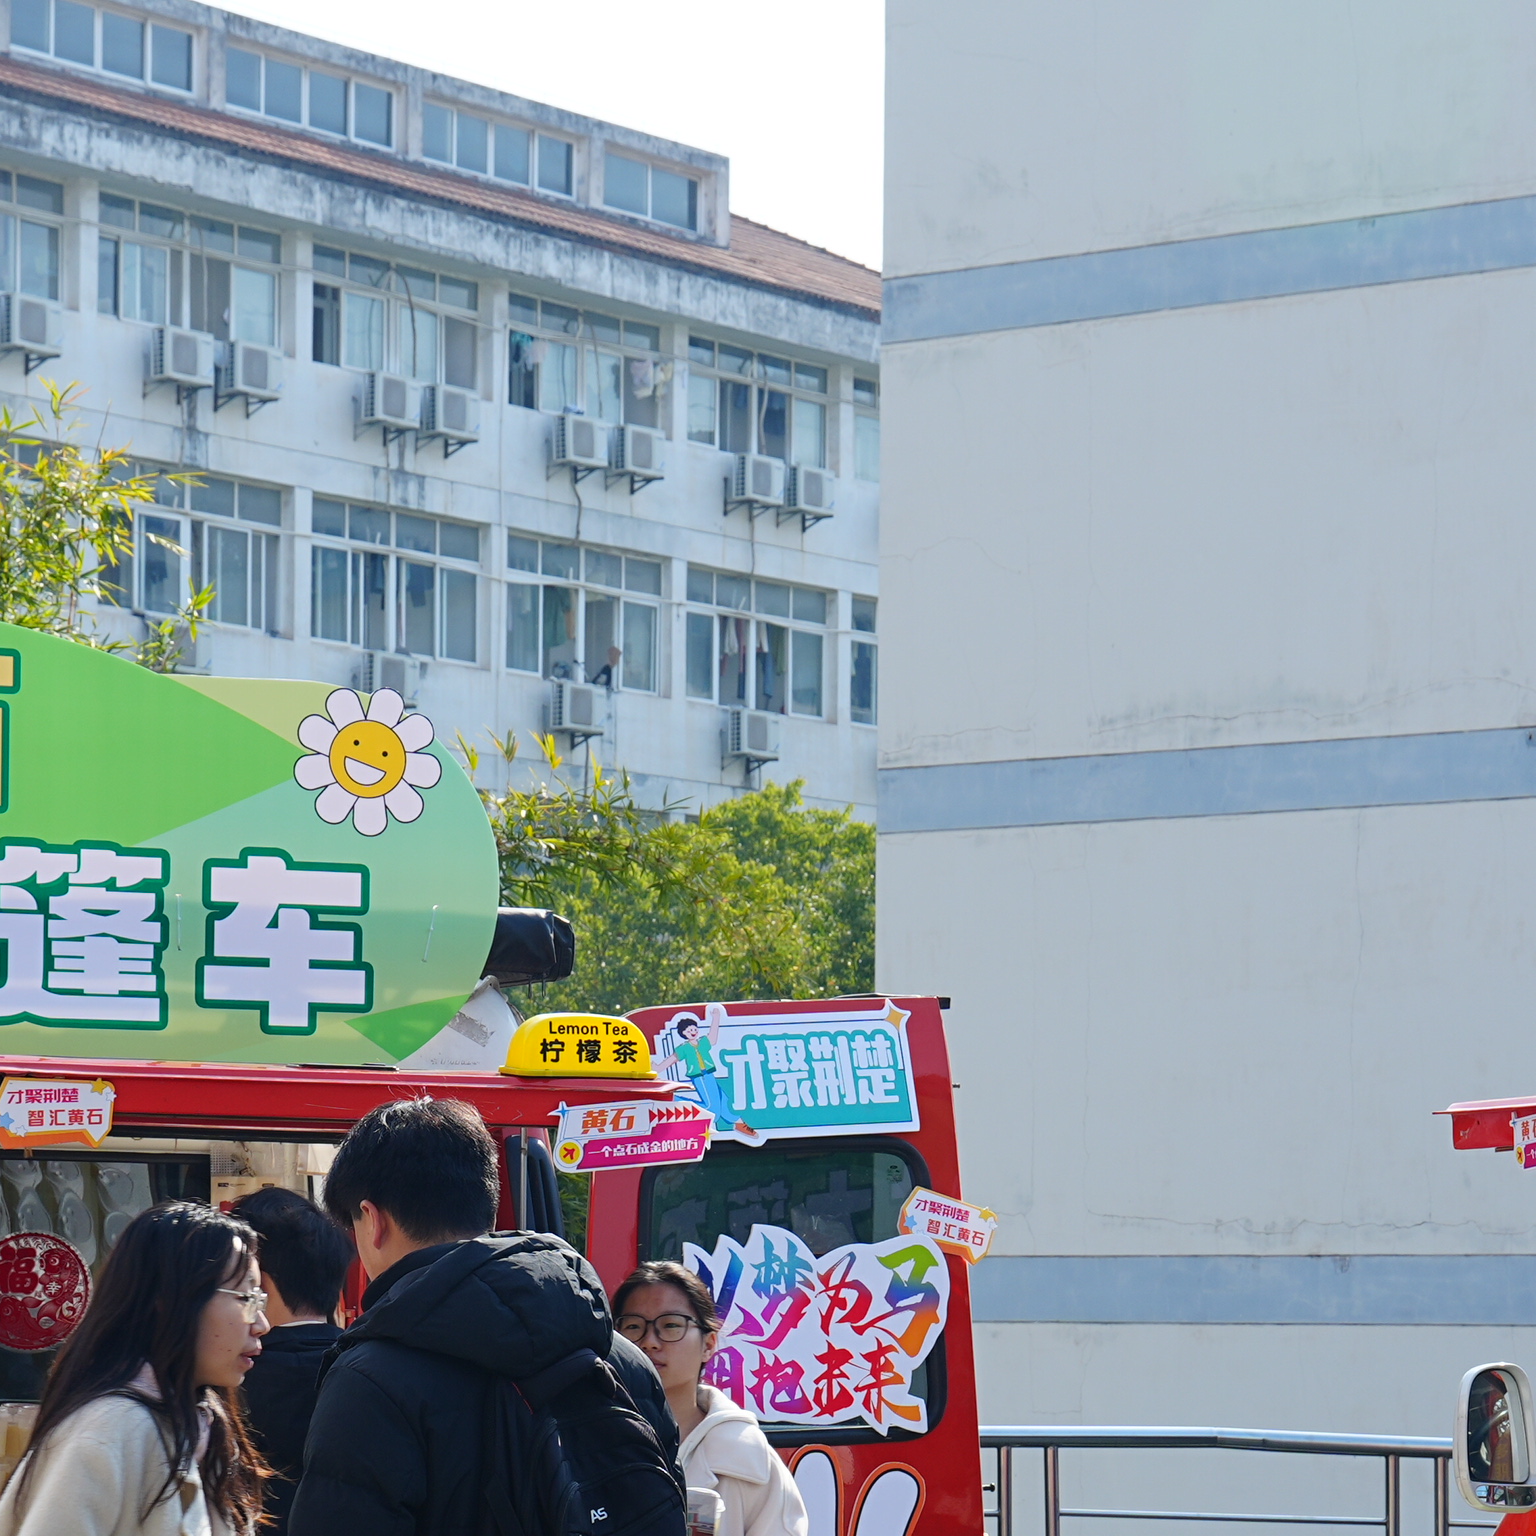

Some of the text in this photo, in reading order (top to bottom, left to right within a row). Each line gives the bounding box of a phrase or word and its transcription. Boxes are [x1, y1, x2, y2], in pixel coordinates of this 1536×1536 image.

[549, 1020, 629, 1036] Lemon Tea
[540, 1039, 638, 1064] 柠檬茶
[727, 1033, 900, 1109] 才聚荆楚
[7, 1088, 79, 1104] 才聚荆楚
[28, 1109, 103, 1126] 智汇黄石
[581, 1107, 636, 1134] 黄石
[588, 1138, 698, 1157] 一个点石成金的地方
[915, 1199, 970, 1223] 才聚荆楚
[927, 1219, 985, 1246] 智汇黄石
[590, 1507, 608, 1524] AS
